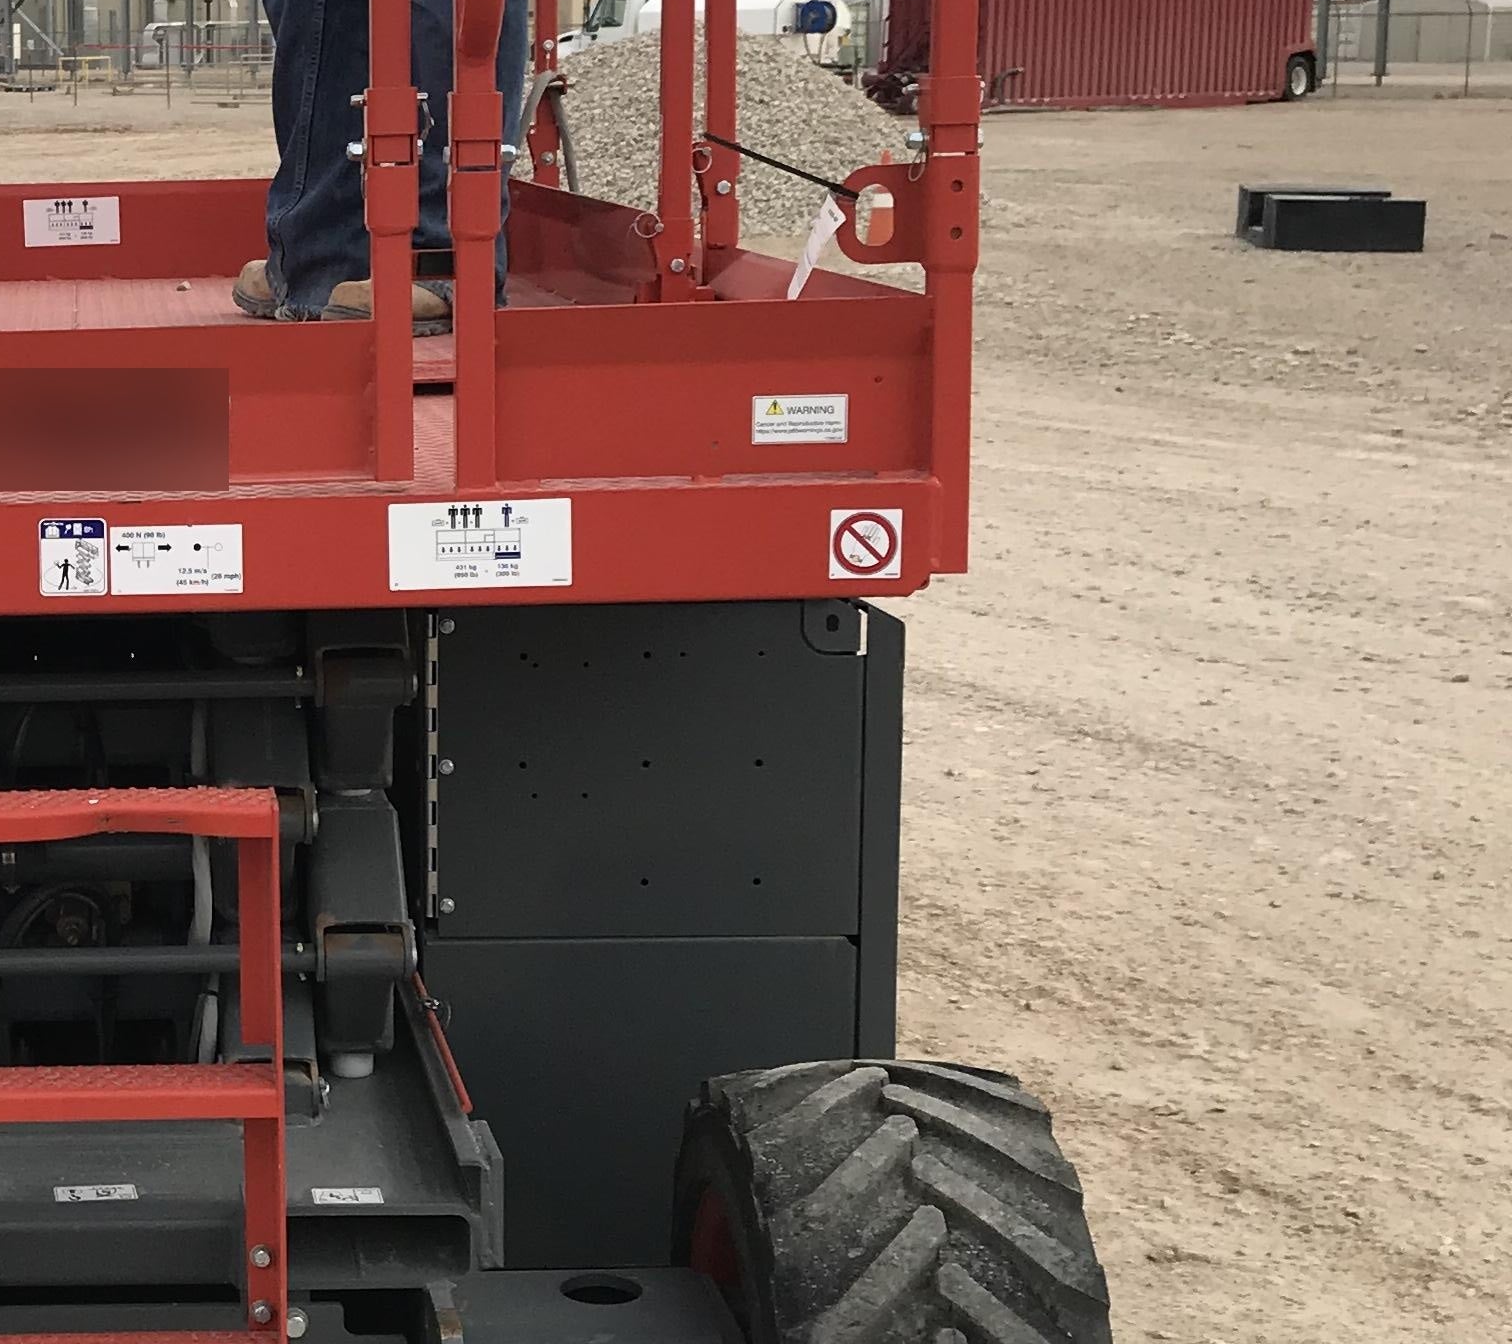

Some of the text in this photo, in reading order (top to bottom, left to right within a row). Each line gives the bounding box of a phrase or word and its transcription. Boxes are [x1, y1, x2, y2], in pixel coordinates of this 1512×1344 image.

[787, 405, 834, 415] WARNING
[121, 531, 135, 539] 400
[136, 531, 142, 539] N
[223, 572, 242, 581] mph)
